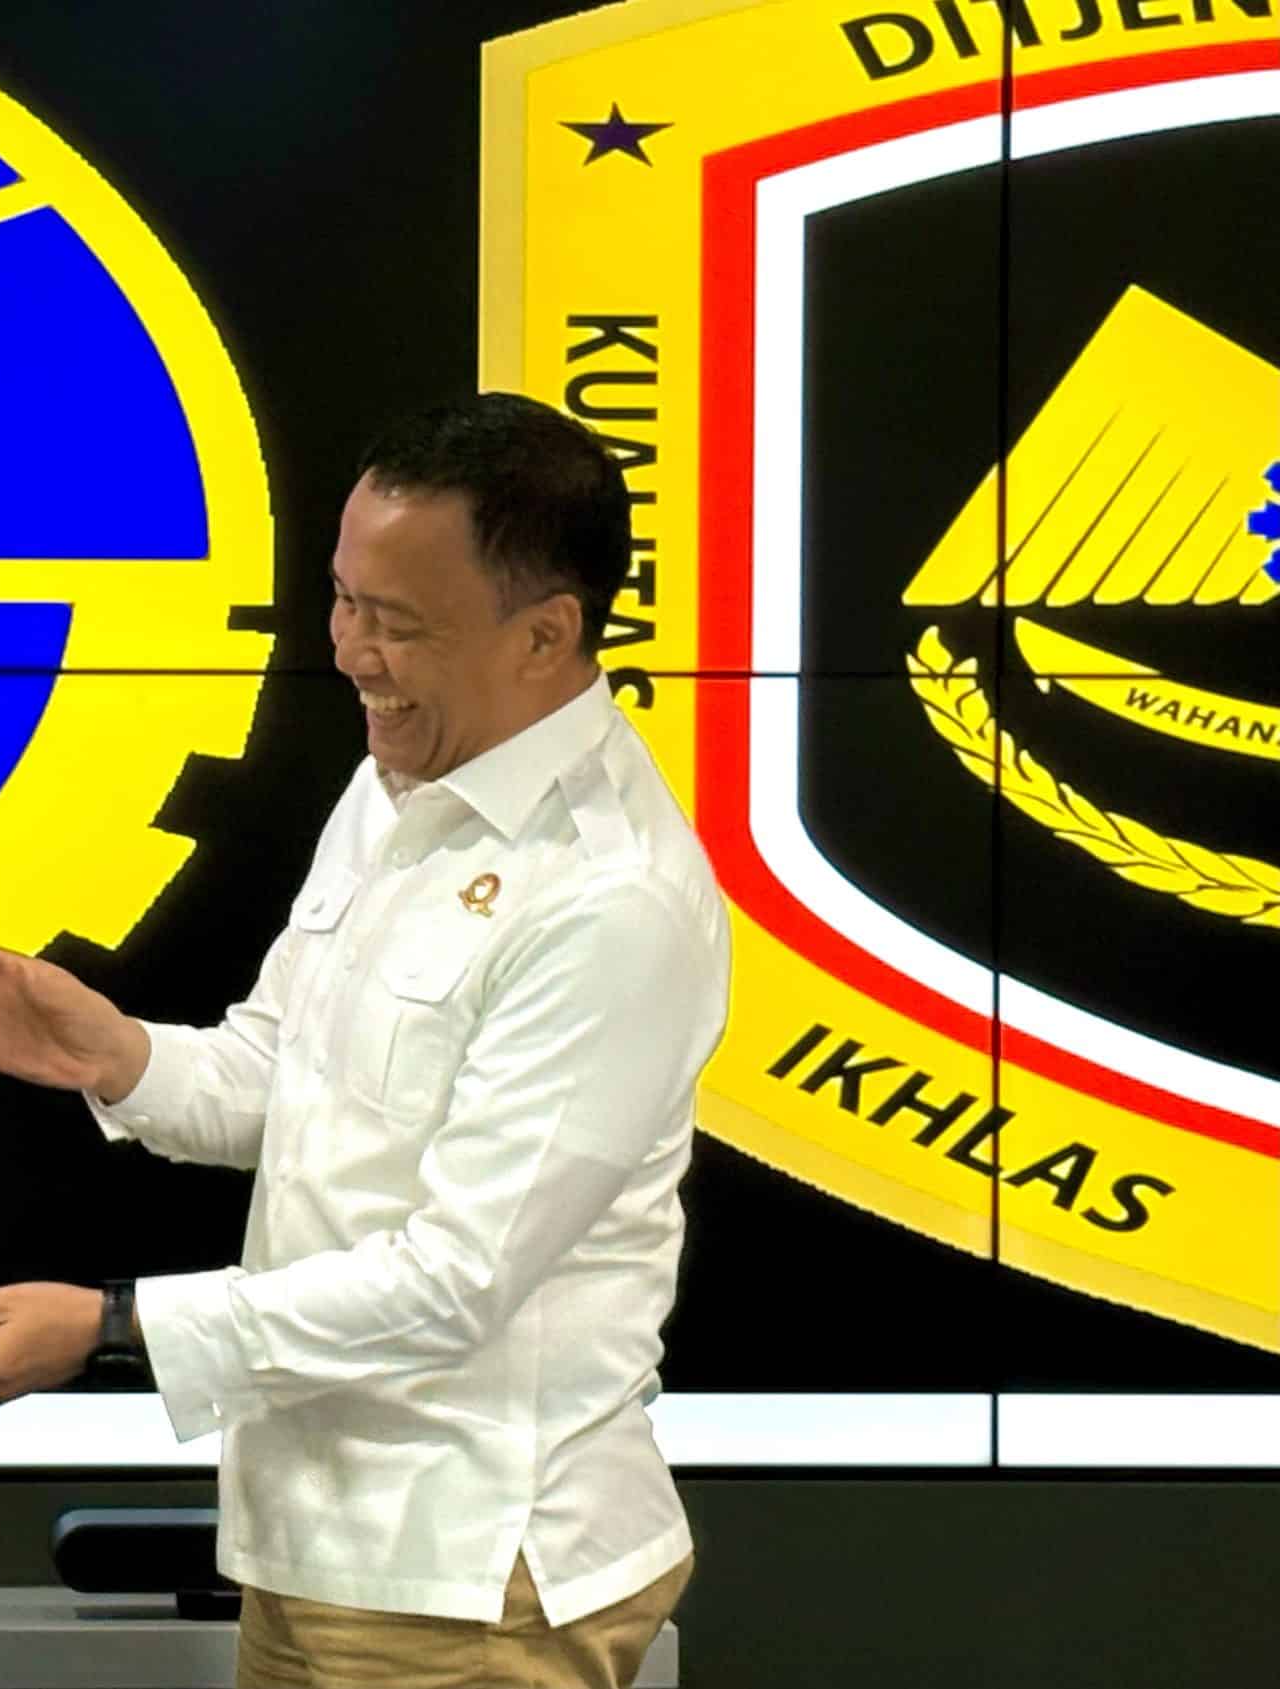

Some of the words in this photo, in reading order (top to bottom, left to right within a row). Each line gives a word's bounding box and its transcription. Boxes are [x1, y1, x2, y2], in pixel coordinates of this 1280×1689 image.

[565, 315, 659, 710] KUATAS
[1124, 687, 1280, 747] WAHAN
[764, 1023, 1177, 1232] IKHLAS
